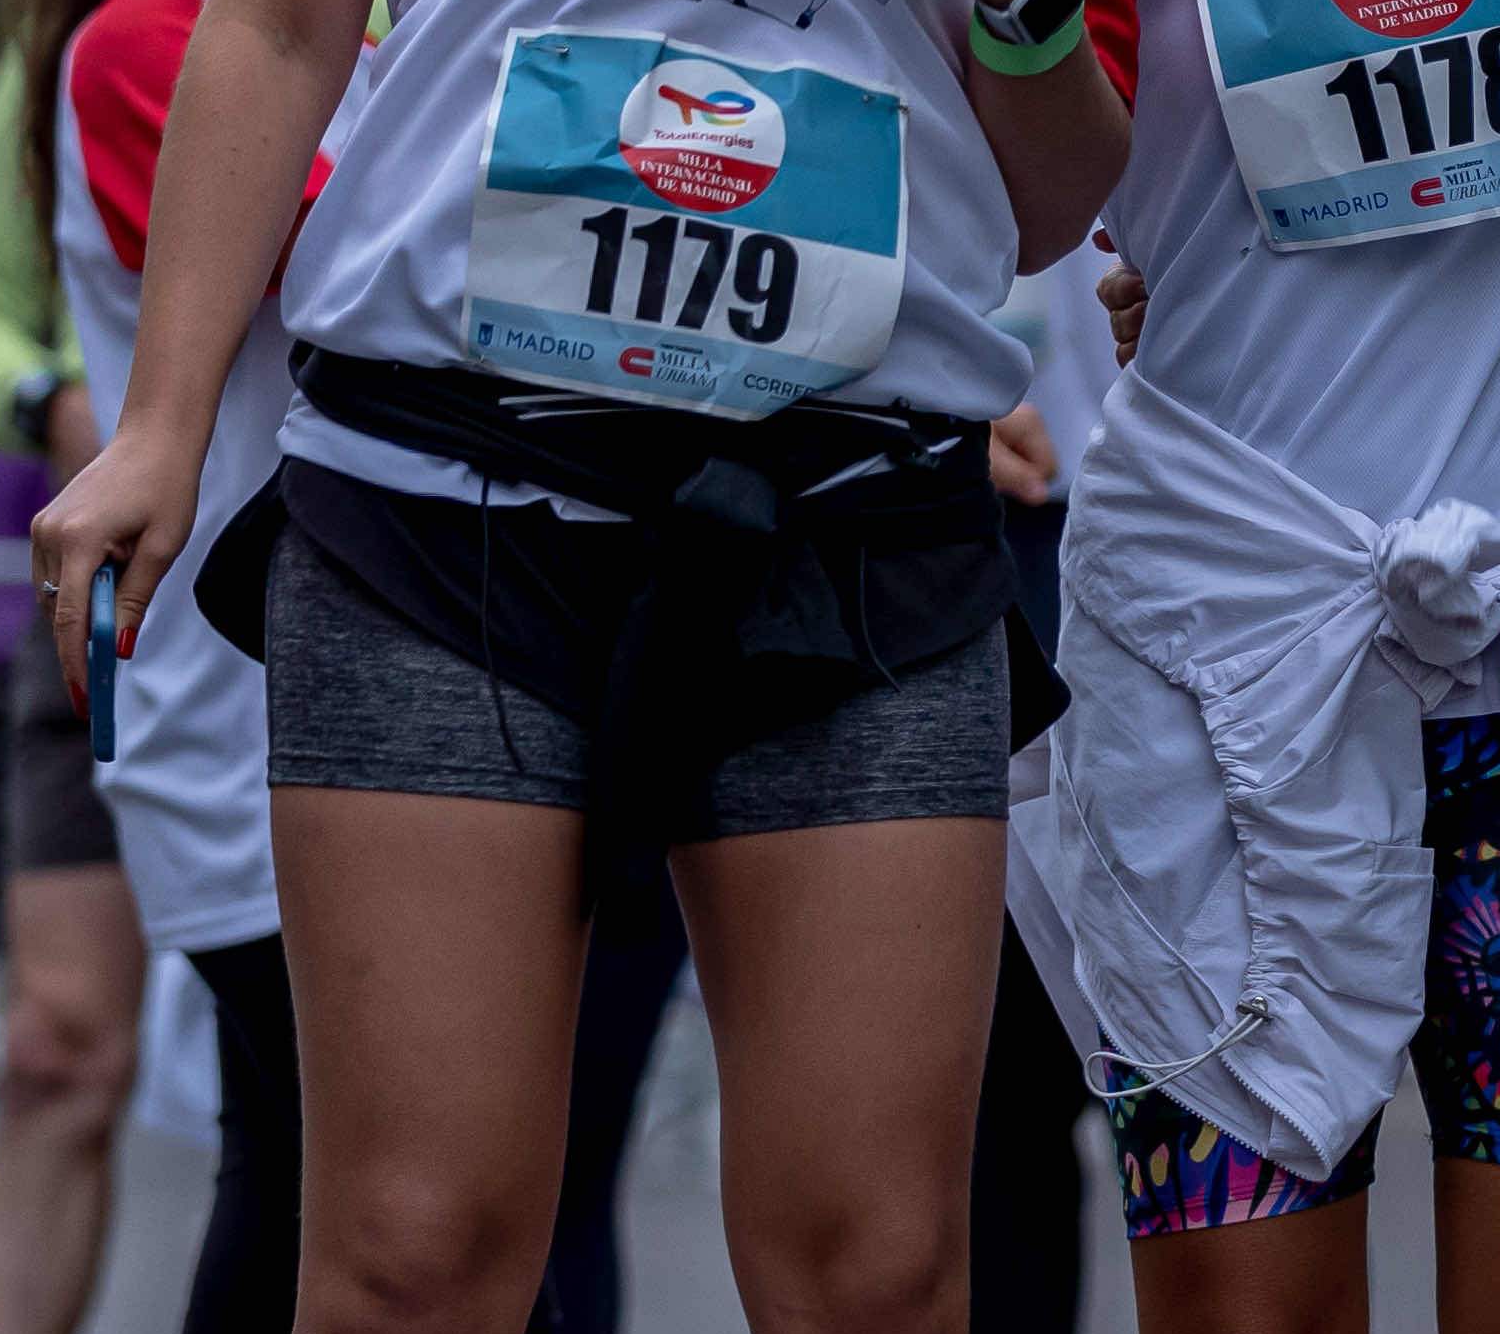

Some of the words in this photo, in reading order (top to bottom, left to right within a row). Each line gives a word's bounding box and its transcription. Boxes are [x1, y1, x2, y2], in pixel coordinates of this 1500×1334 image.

[1379, 15, 1400, 30] DE
[1402, 2, 1459, 24] MADRID
[654, 129, 755, 149] TotalEnergies
[678, 152, 723, 172] MILLA
[1445, 166, 1496, 186] MILLA
[657, 177, 677, 192] DE
[680, 182, 736, 204] MADRID
[1301, 191, 1390, 223] MADRID
[581, 207, 799, 344] 1179
[505, 330, 595, 361] MADRID
[658, 350, 712, 372] MILLA
[654, 368, 717, 391] URBANA
